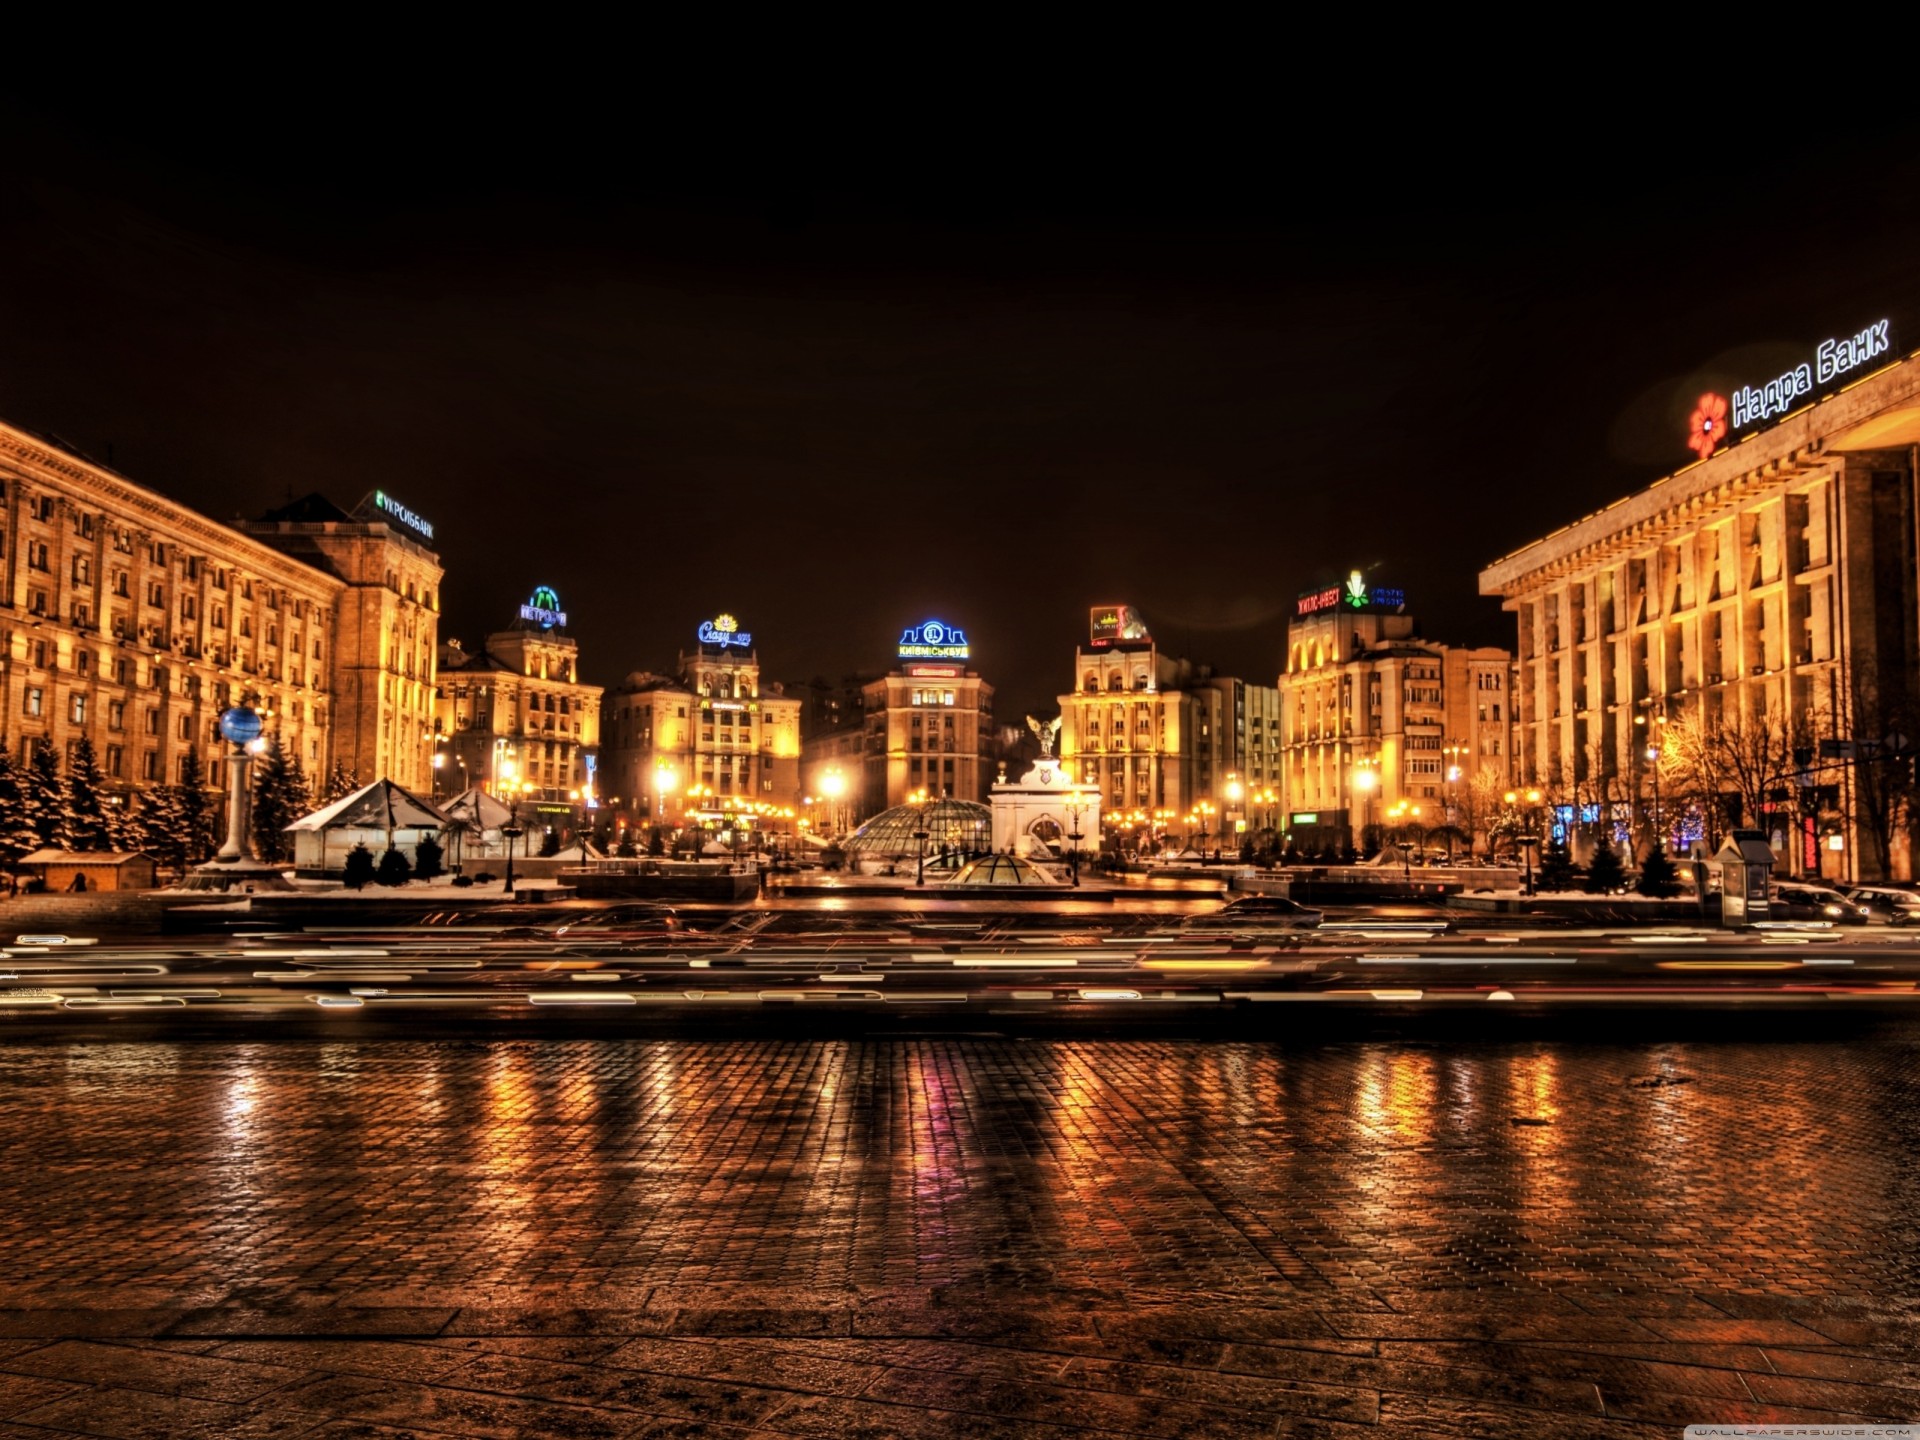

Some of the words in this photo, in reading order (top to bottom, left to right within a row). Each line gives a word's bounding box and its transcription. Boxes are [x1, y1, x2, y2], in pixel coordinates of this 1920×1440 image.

[1732, 363, 1811, 428] Надра
[1817, 319, 1889, 384] Банк
[383, 494, 434, 539] УКРСИББАНК
[899, 645, 968, 657] КИЇВМІСЬКБУД
